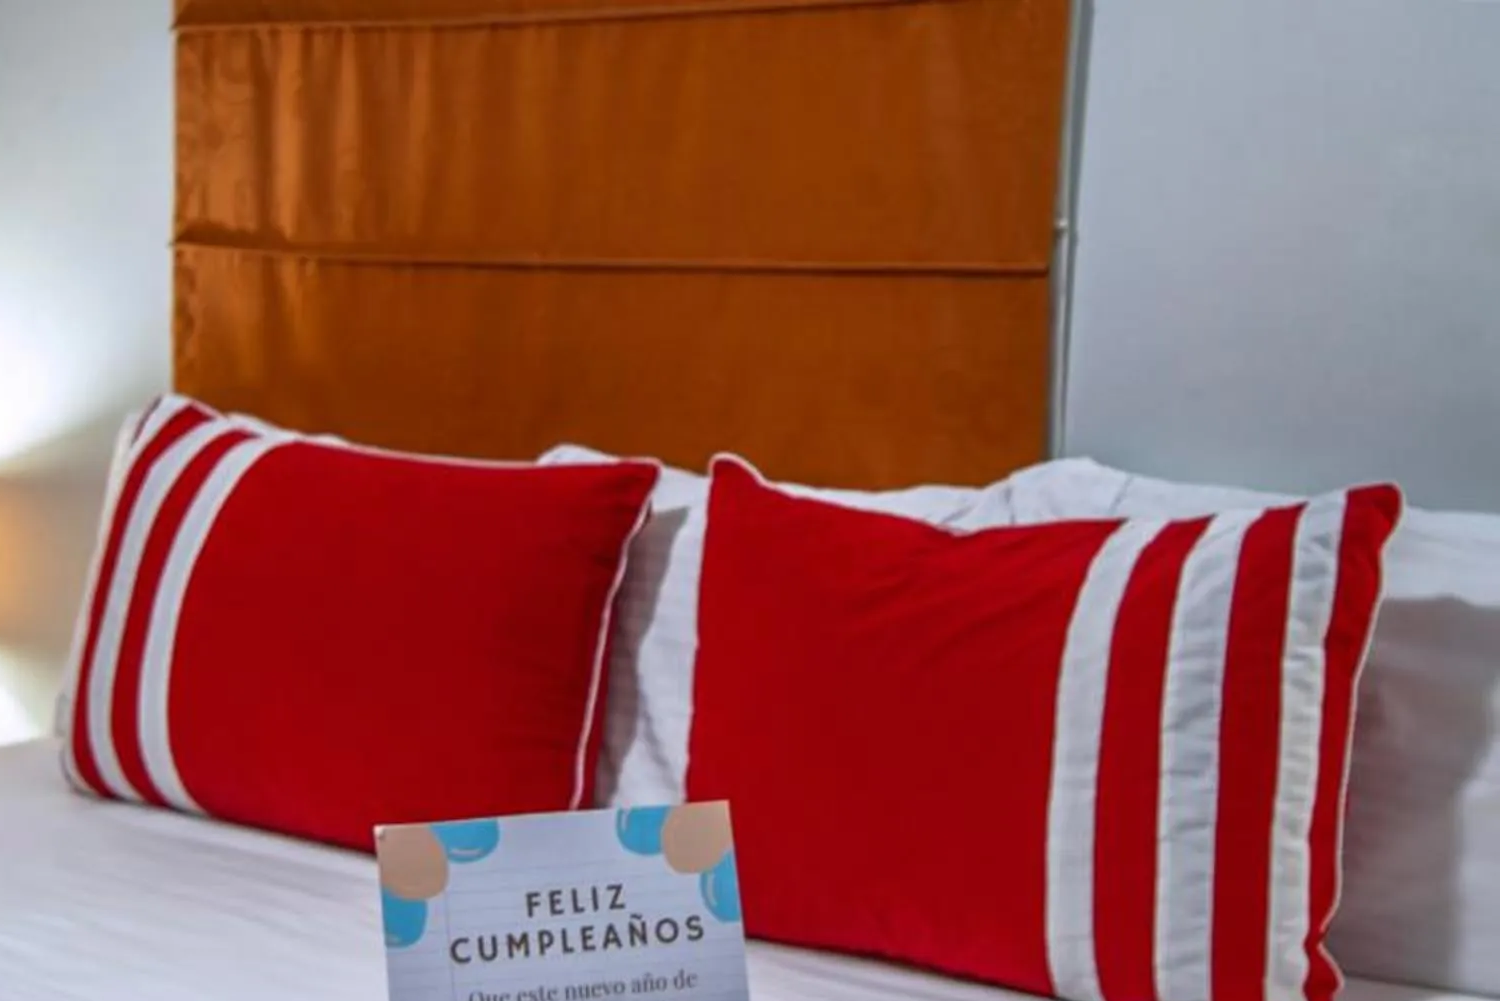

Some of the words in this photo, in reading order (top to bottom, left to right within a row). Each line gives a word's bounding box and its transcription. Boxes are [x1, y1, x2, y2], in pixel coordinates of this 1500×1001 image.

[525, 883, 627, 919] FELIZ
[449, 912, 706, 965] CUMPLEAÑOS
[564, 979, 627, 1001] nuevo
[630, 971, 668, 995] año
[673, 967, 698, 990] de
